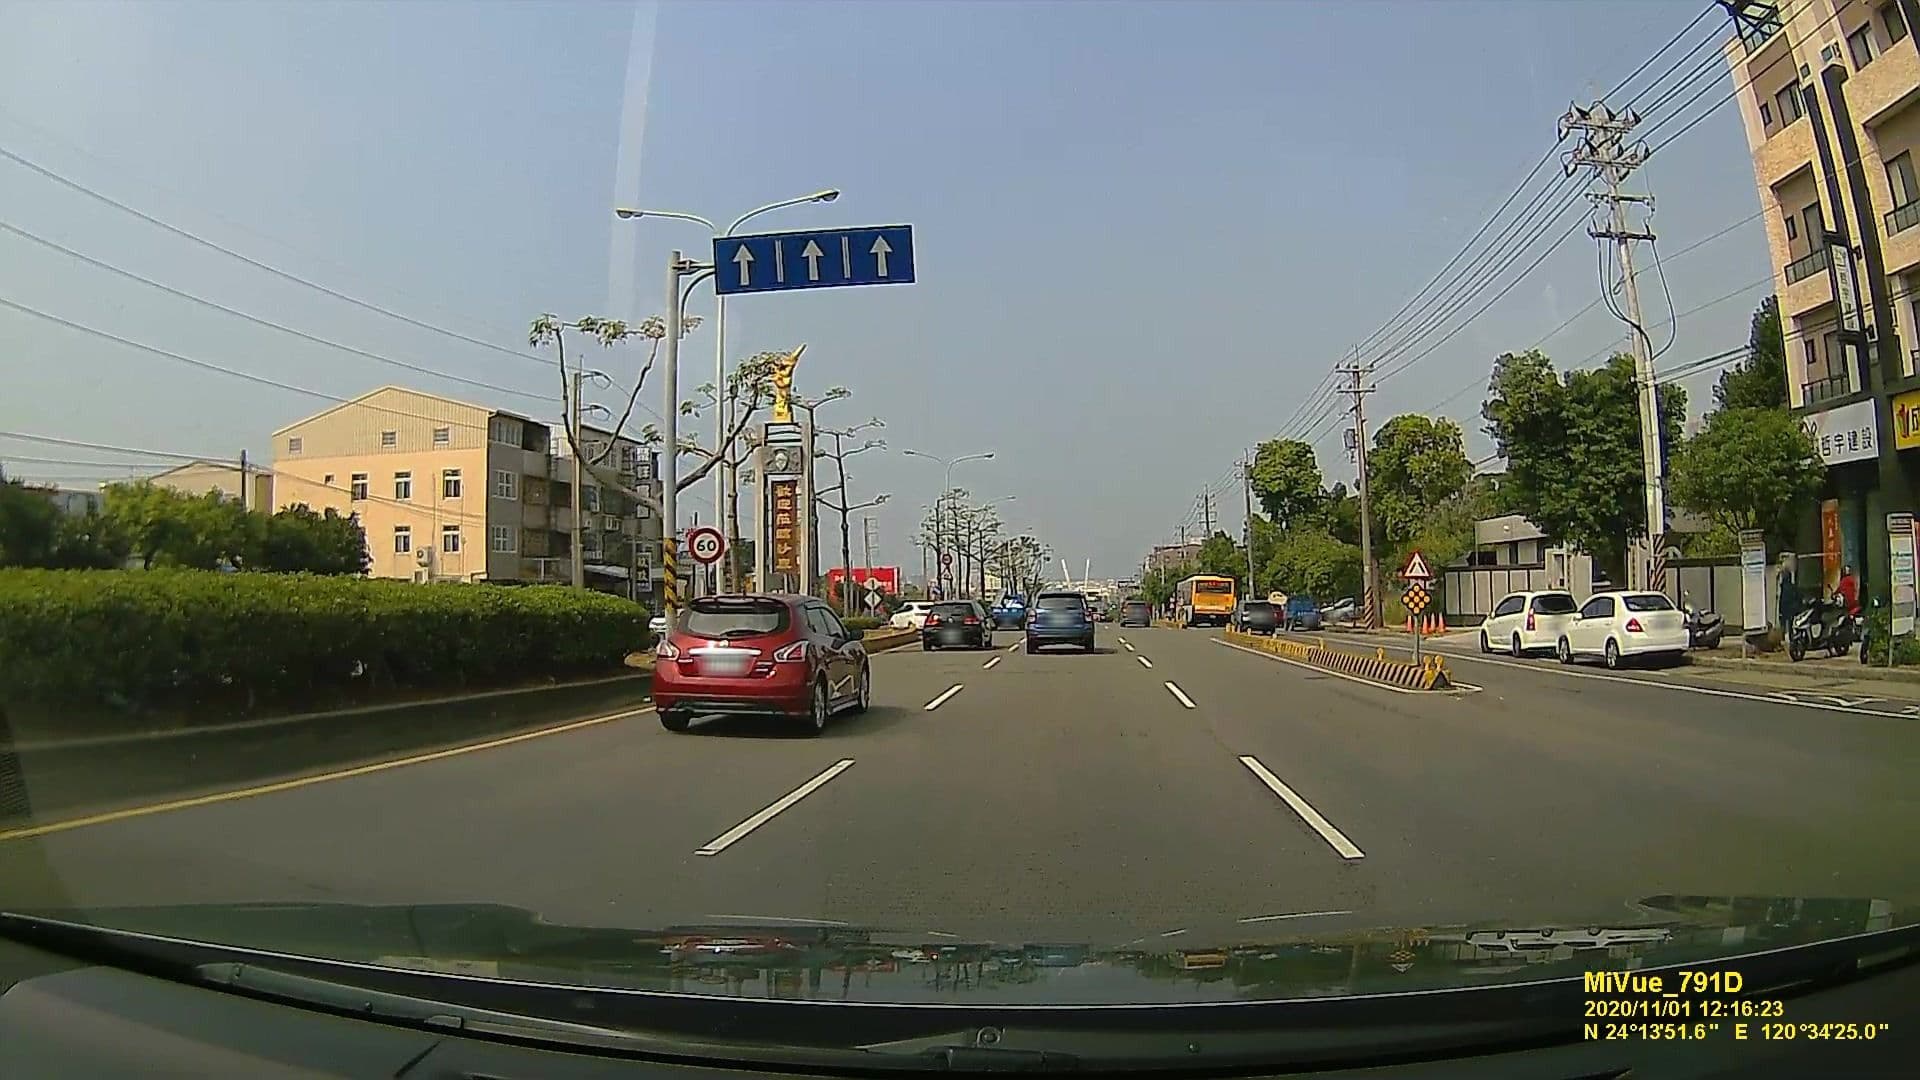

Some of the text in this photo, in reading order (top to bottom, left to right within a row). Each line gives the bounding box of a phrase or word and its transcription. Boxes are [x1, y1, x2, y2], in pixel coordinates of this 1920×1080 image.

[1821, 426, 1873, 457] 哲宇建設
[696, 540, 717, 552] 60
